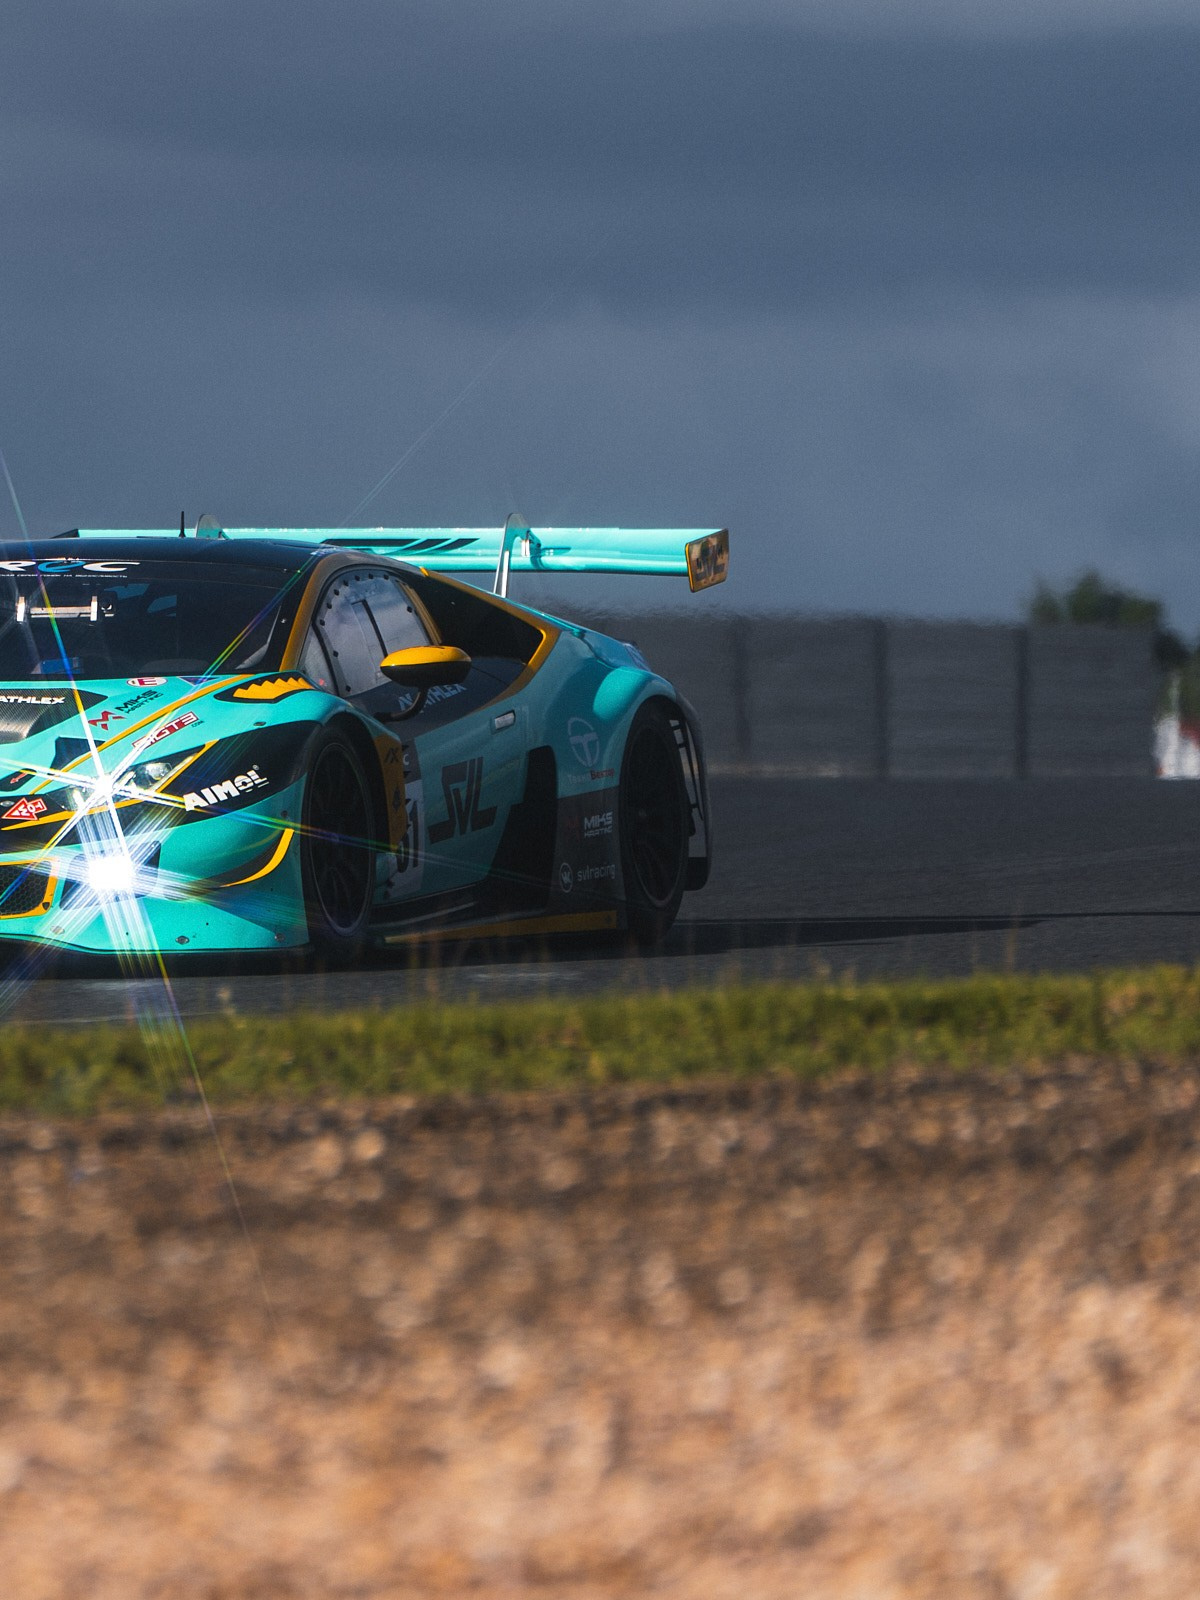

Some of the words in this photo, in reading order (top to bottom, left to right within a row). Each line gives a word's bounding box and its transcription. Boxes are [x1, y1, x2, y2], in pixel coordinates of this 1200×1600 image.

[183, 768, 270, 812] AIMOL
[427, 757, 498, 845] SVL
[583, 811, 614, 831] MIKS
